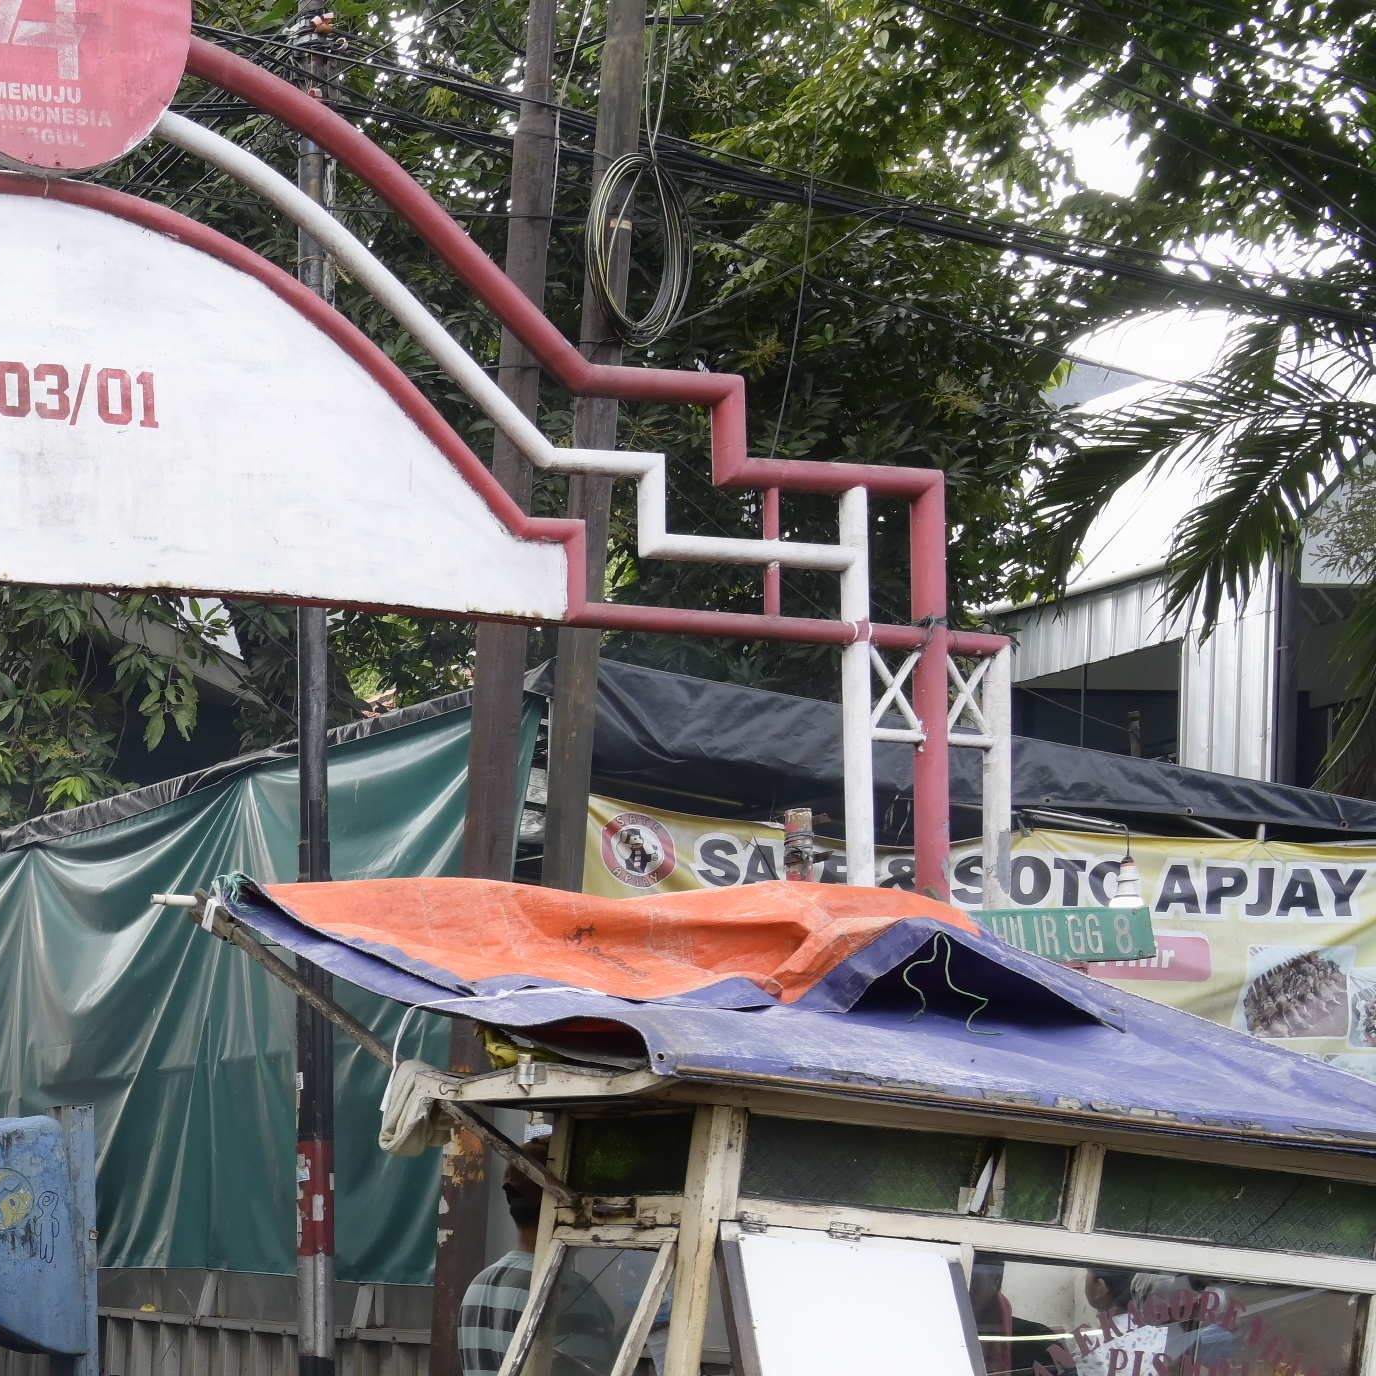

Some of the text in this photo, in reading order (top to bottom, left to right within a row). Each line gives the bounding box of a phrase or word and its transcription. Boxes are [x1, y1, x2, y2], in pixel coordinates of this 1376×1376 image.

[697, 838, 847, 888] SAE
[1155, 864, 1367, 917] APJAY
[1066, 913, 1104, 954] GG
[1114, 914, 1134, 954] 8
